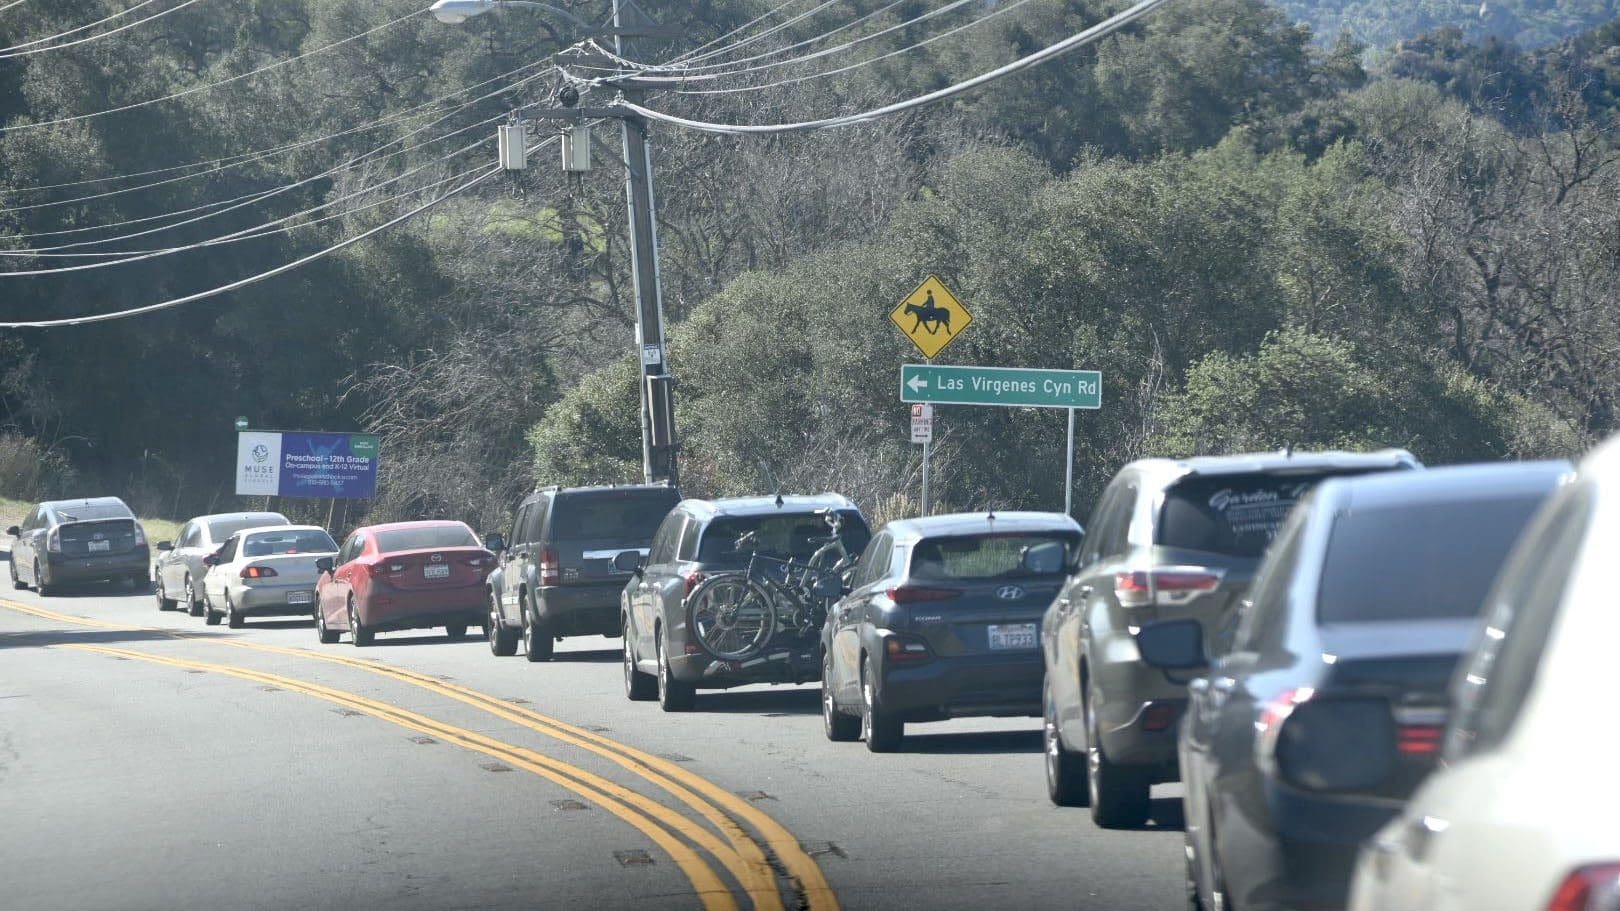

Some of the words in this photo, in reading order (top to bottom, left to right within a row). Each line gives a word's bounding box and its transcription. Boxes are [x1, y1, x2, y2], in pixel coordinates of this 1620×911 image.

[937, 376, 964, 390] Las
[971, 376, 1036, 395] Virgenes
[1043, 380, 1072, 397] Cyn
[1078, 381, 1097, 395] Rd
[913, 406, 921, 416] NO
[286, 454, 323, 462] Preschool
[329, 455, 345, 463] 12th
[244, 465, 273, 473] MUSE
[285, 462, 320, 470] On-campus
